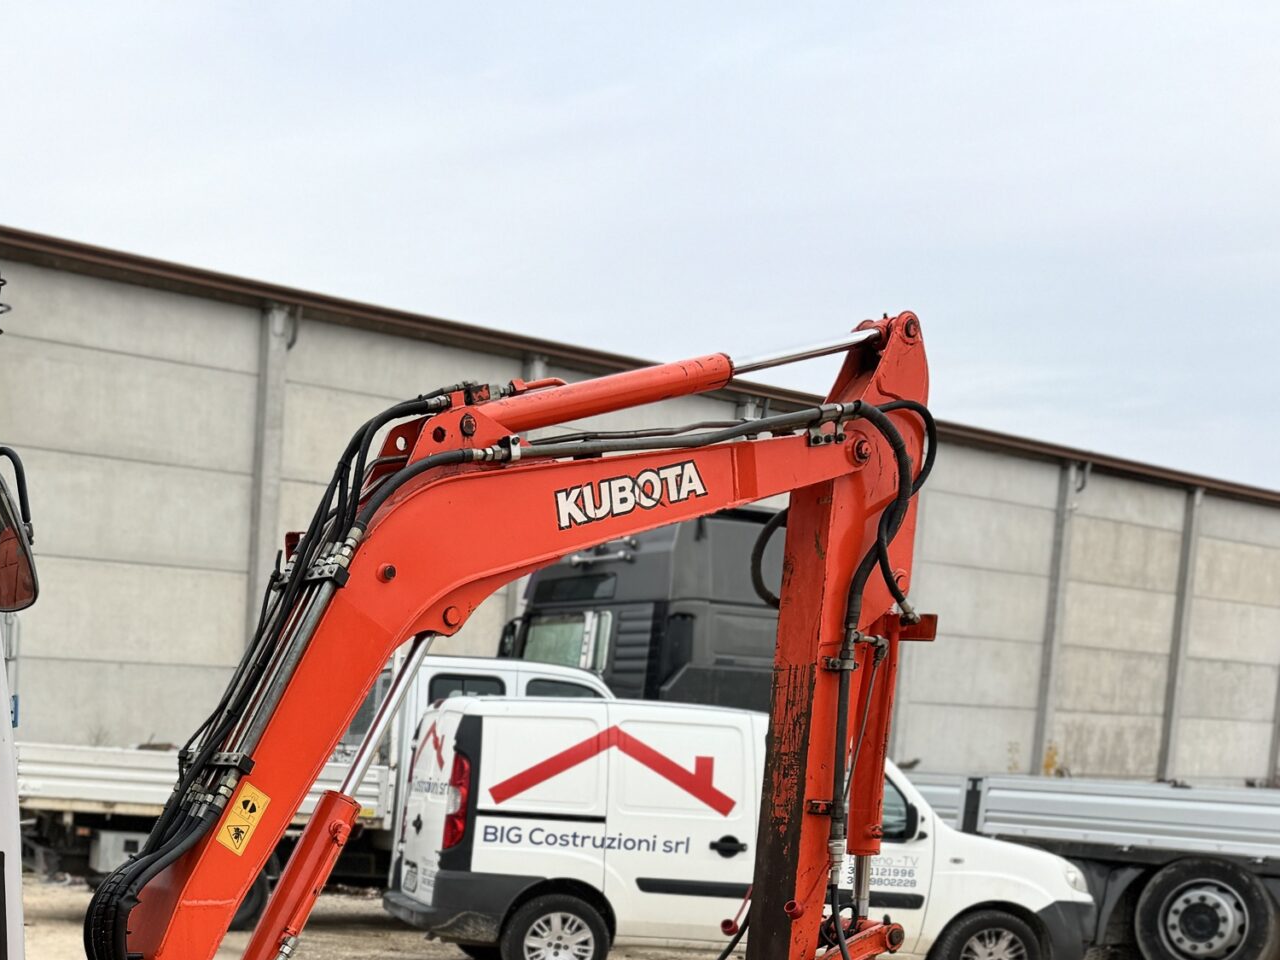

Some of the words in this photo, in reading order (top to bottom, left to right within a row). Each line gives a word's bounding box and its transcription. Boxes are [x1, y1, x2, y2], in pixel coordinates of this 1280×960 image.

[554, 459, 708, 530] KUBOTA
[482, 824, 522, 844] BIG
[528, 827, 657, 852] Costruzioni
[662, 836, 690, 854] srl
